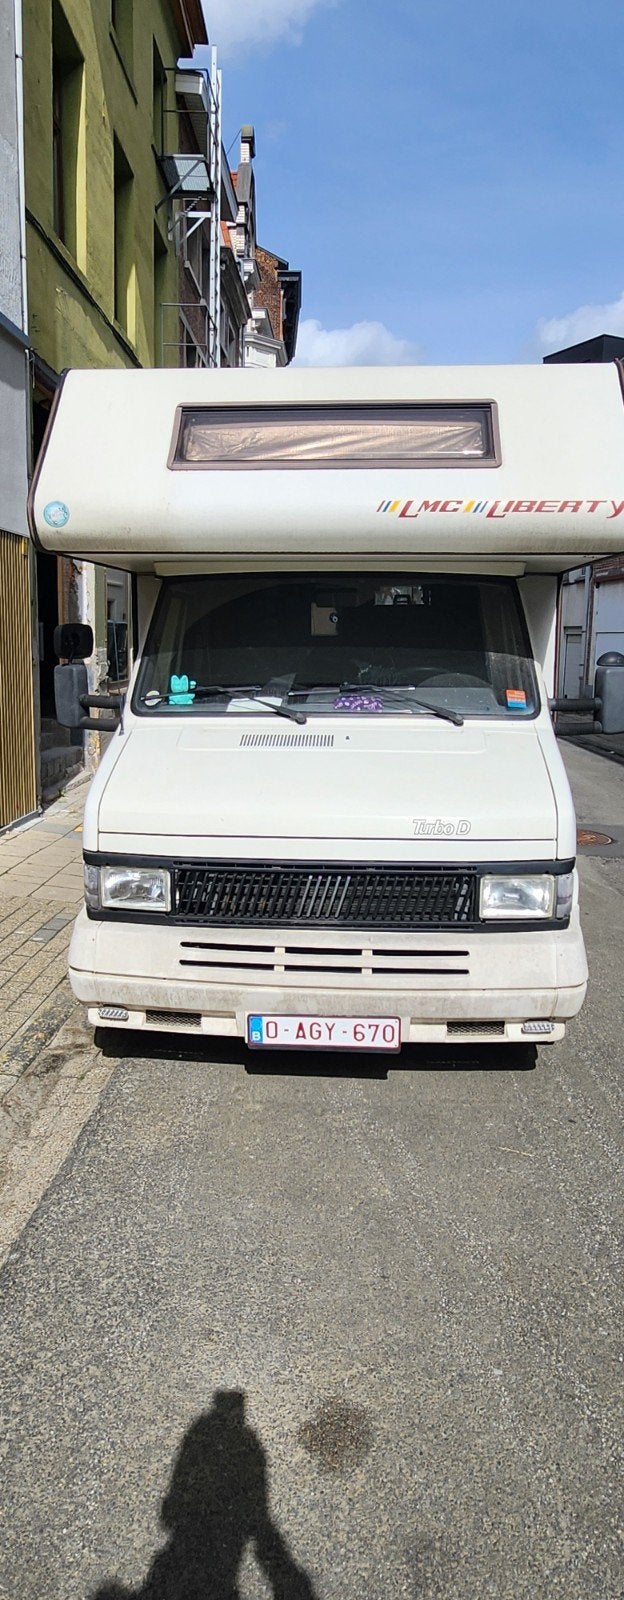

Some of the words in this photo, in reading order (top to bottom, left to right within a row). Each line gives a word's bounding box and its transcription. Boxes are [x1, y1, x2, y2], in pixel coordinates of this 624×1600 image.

[398, 499, 464, 519] LMC
[412, 818, 455, 836] Turbo
[456, 819, 472, 836] D
[251, 1031, 262, 1042] B
